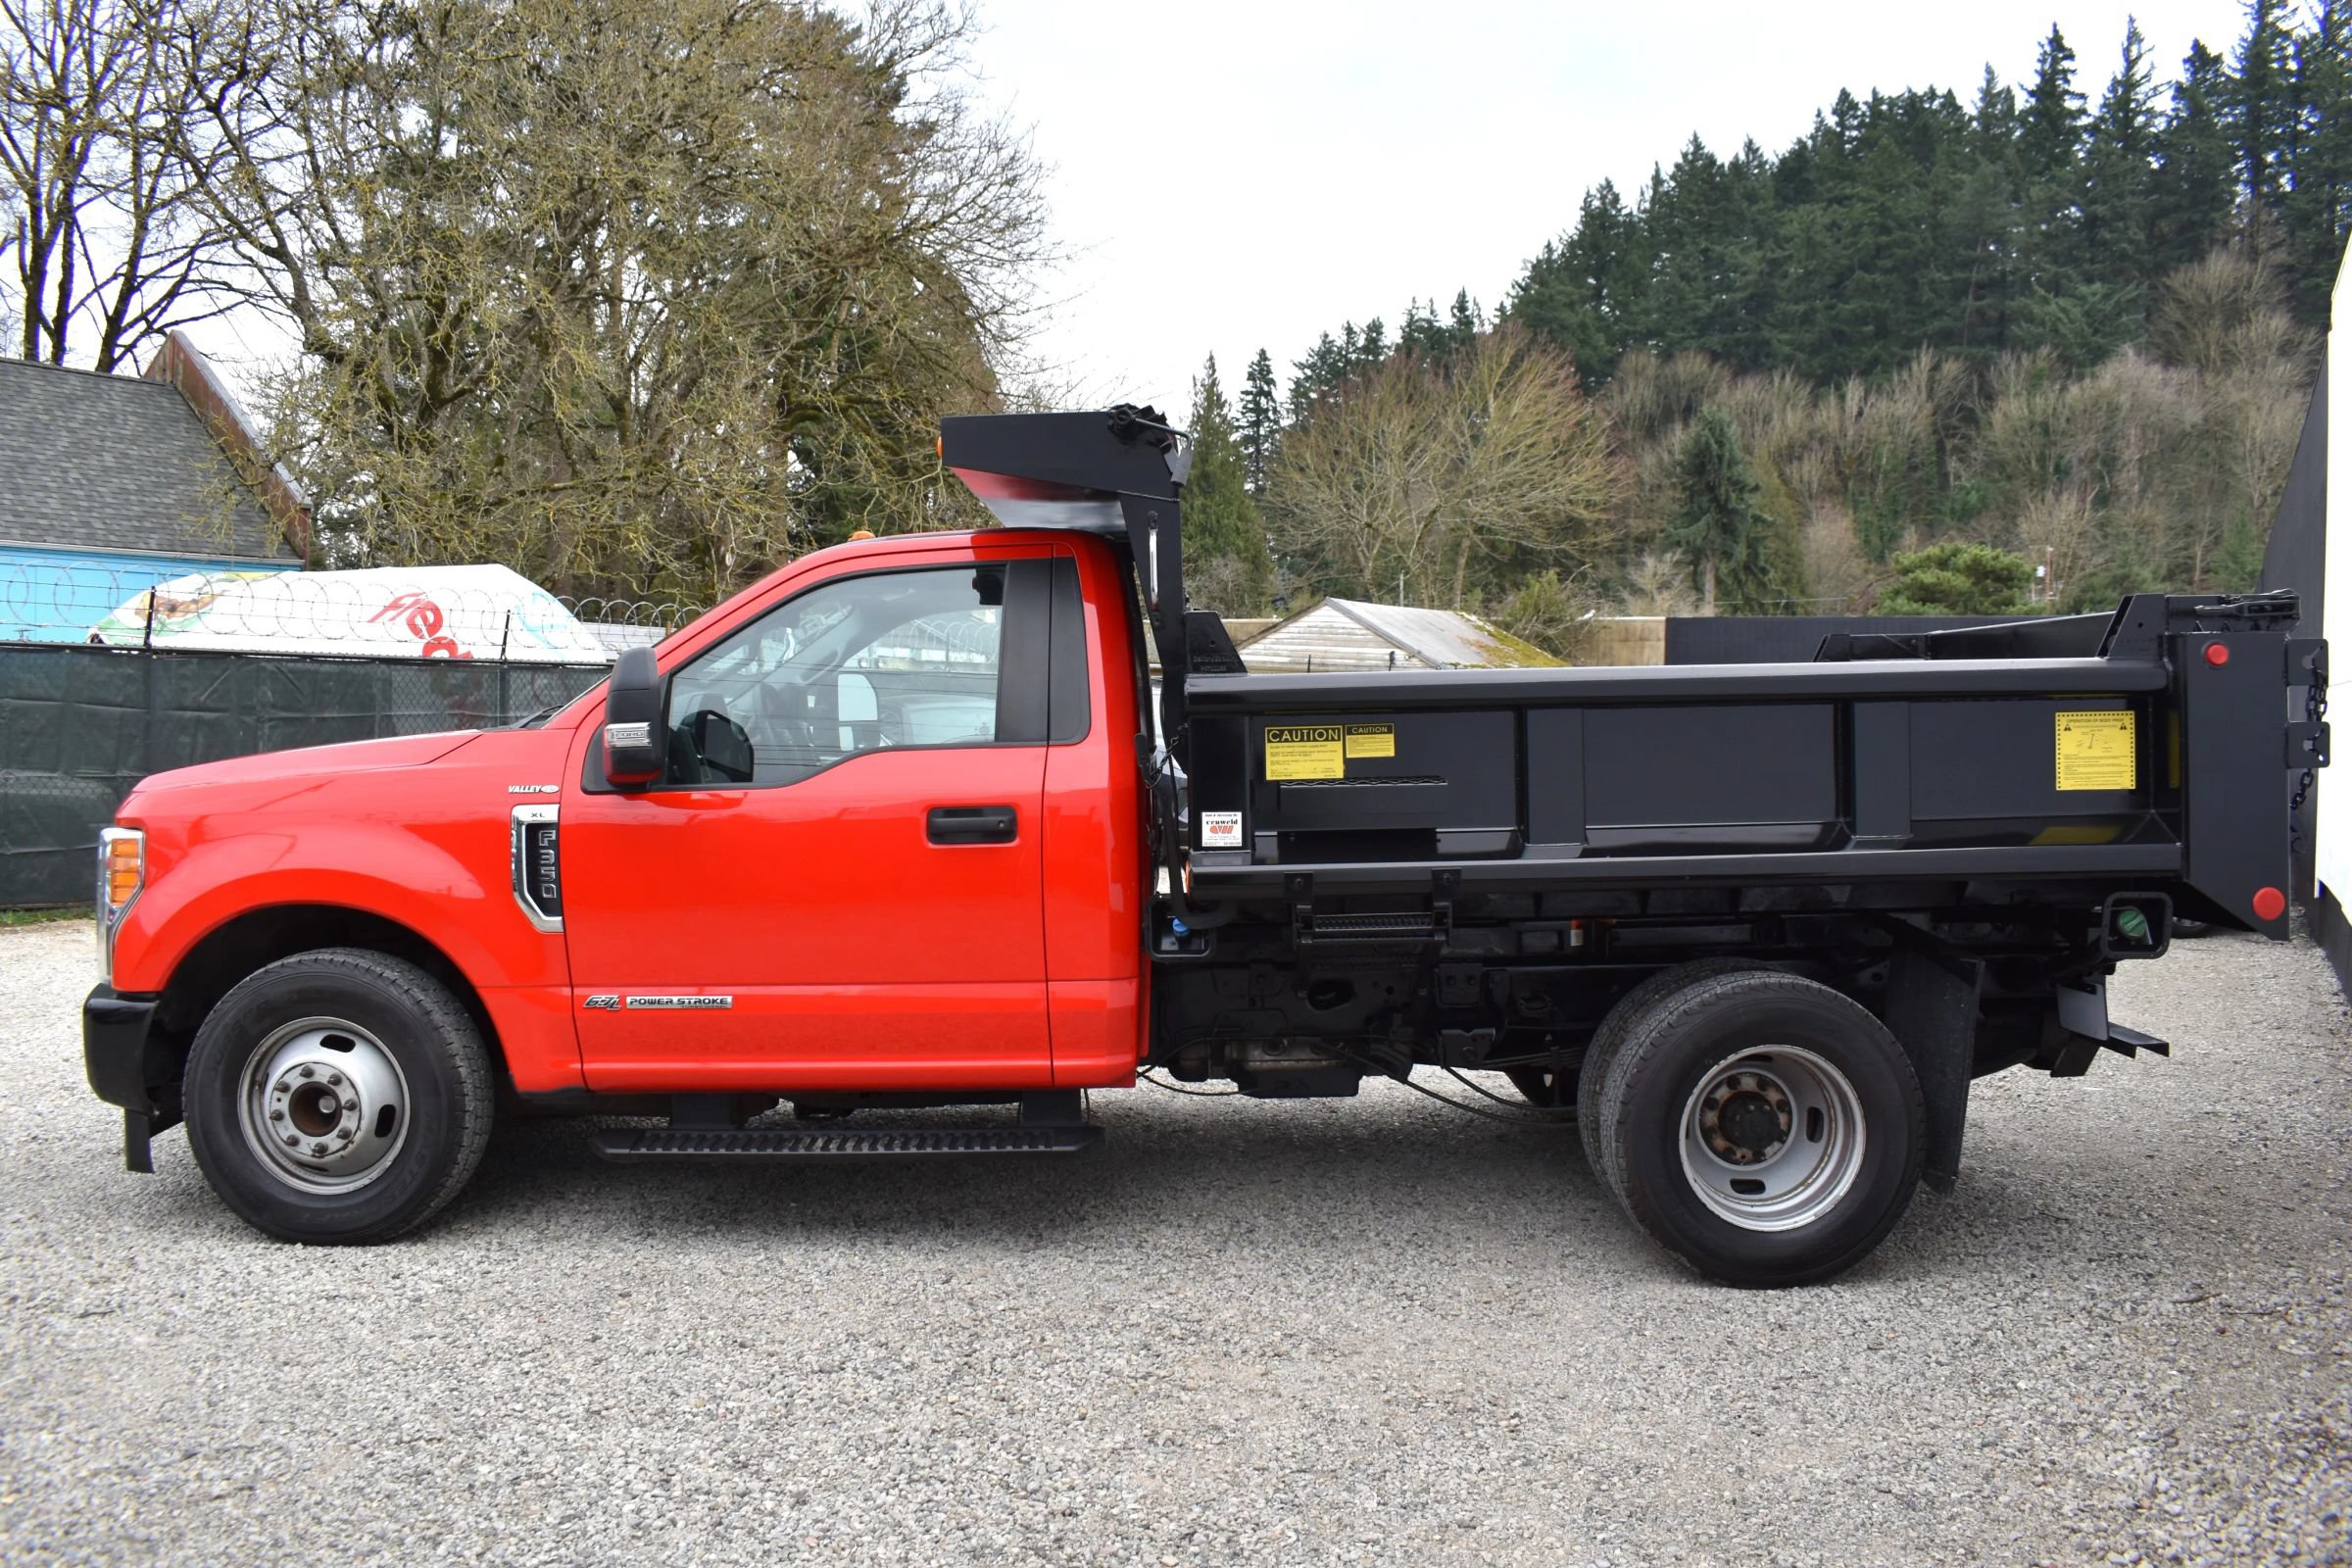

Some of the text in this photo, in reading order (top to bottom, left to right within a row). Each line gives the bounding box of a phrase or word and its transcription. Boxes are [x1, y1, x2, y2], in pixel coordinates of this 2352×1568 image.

[1269, 728, 1339, 742] CAUTION
[508, 784, 541, 793] VALLEY
[539, 830, 557, 899] F350
